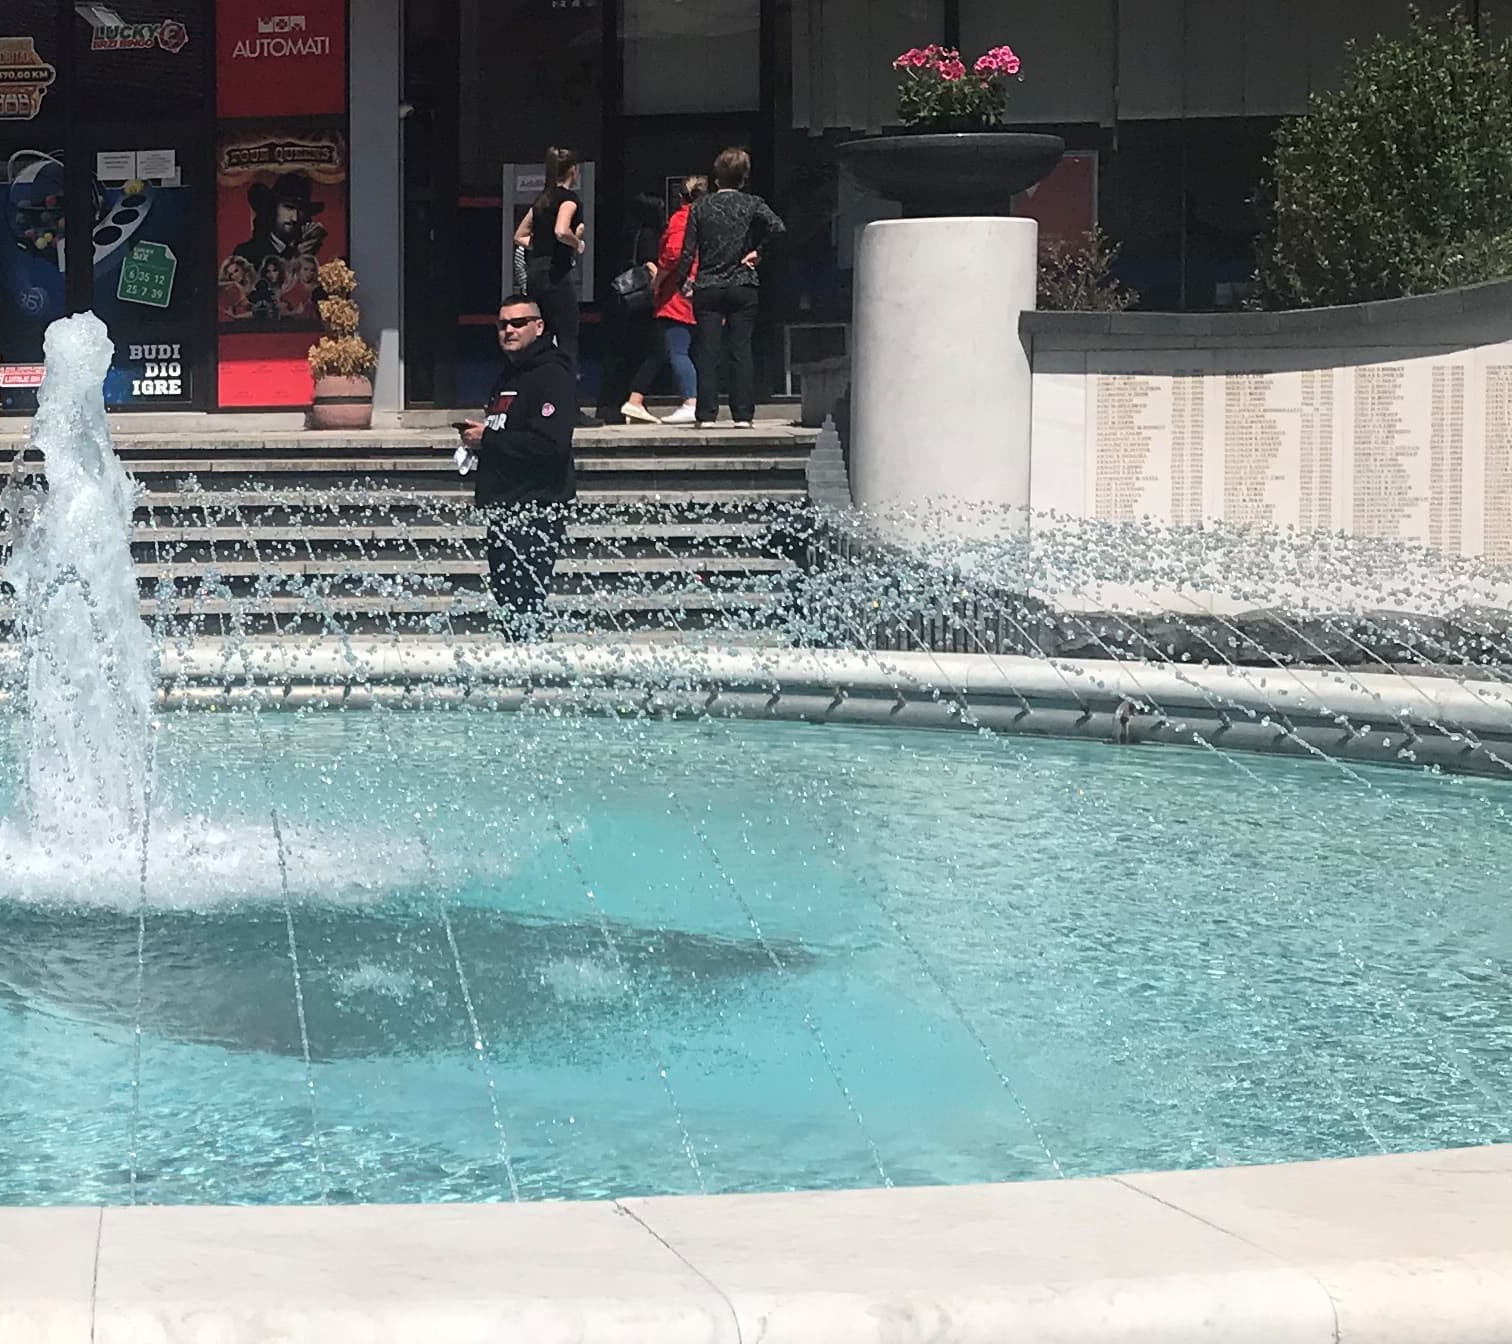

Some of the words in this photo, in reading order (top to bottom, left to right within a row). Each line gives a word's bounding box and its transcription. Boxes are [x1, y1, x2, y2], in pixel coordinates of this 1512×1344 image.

[94, 24, 161, 39] LUCKY
[232, 36, 329, 58] AUTOMATI
[129, 344, 181, 360] BUDI
[145, 362, 181, 377] DIO
[132, 379, 181, 396] IGRE
